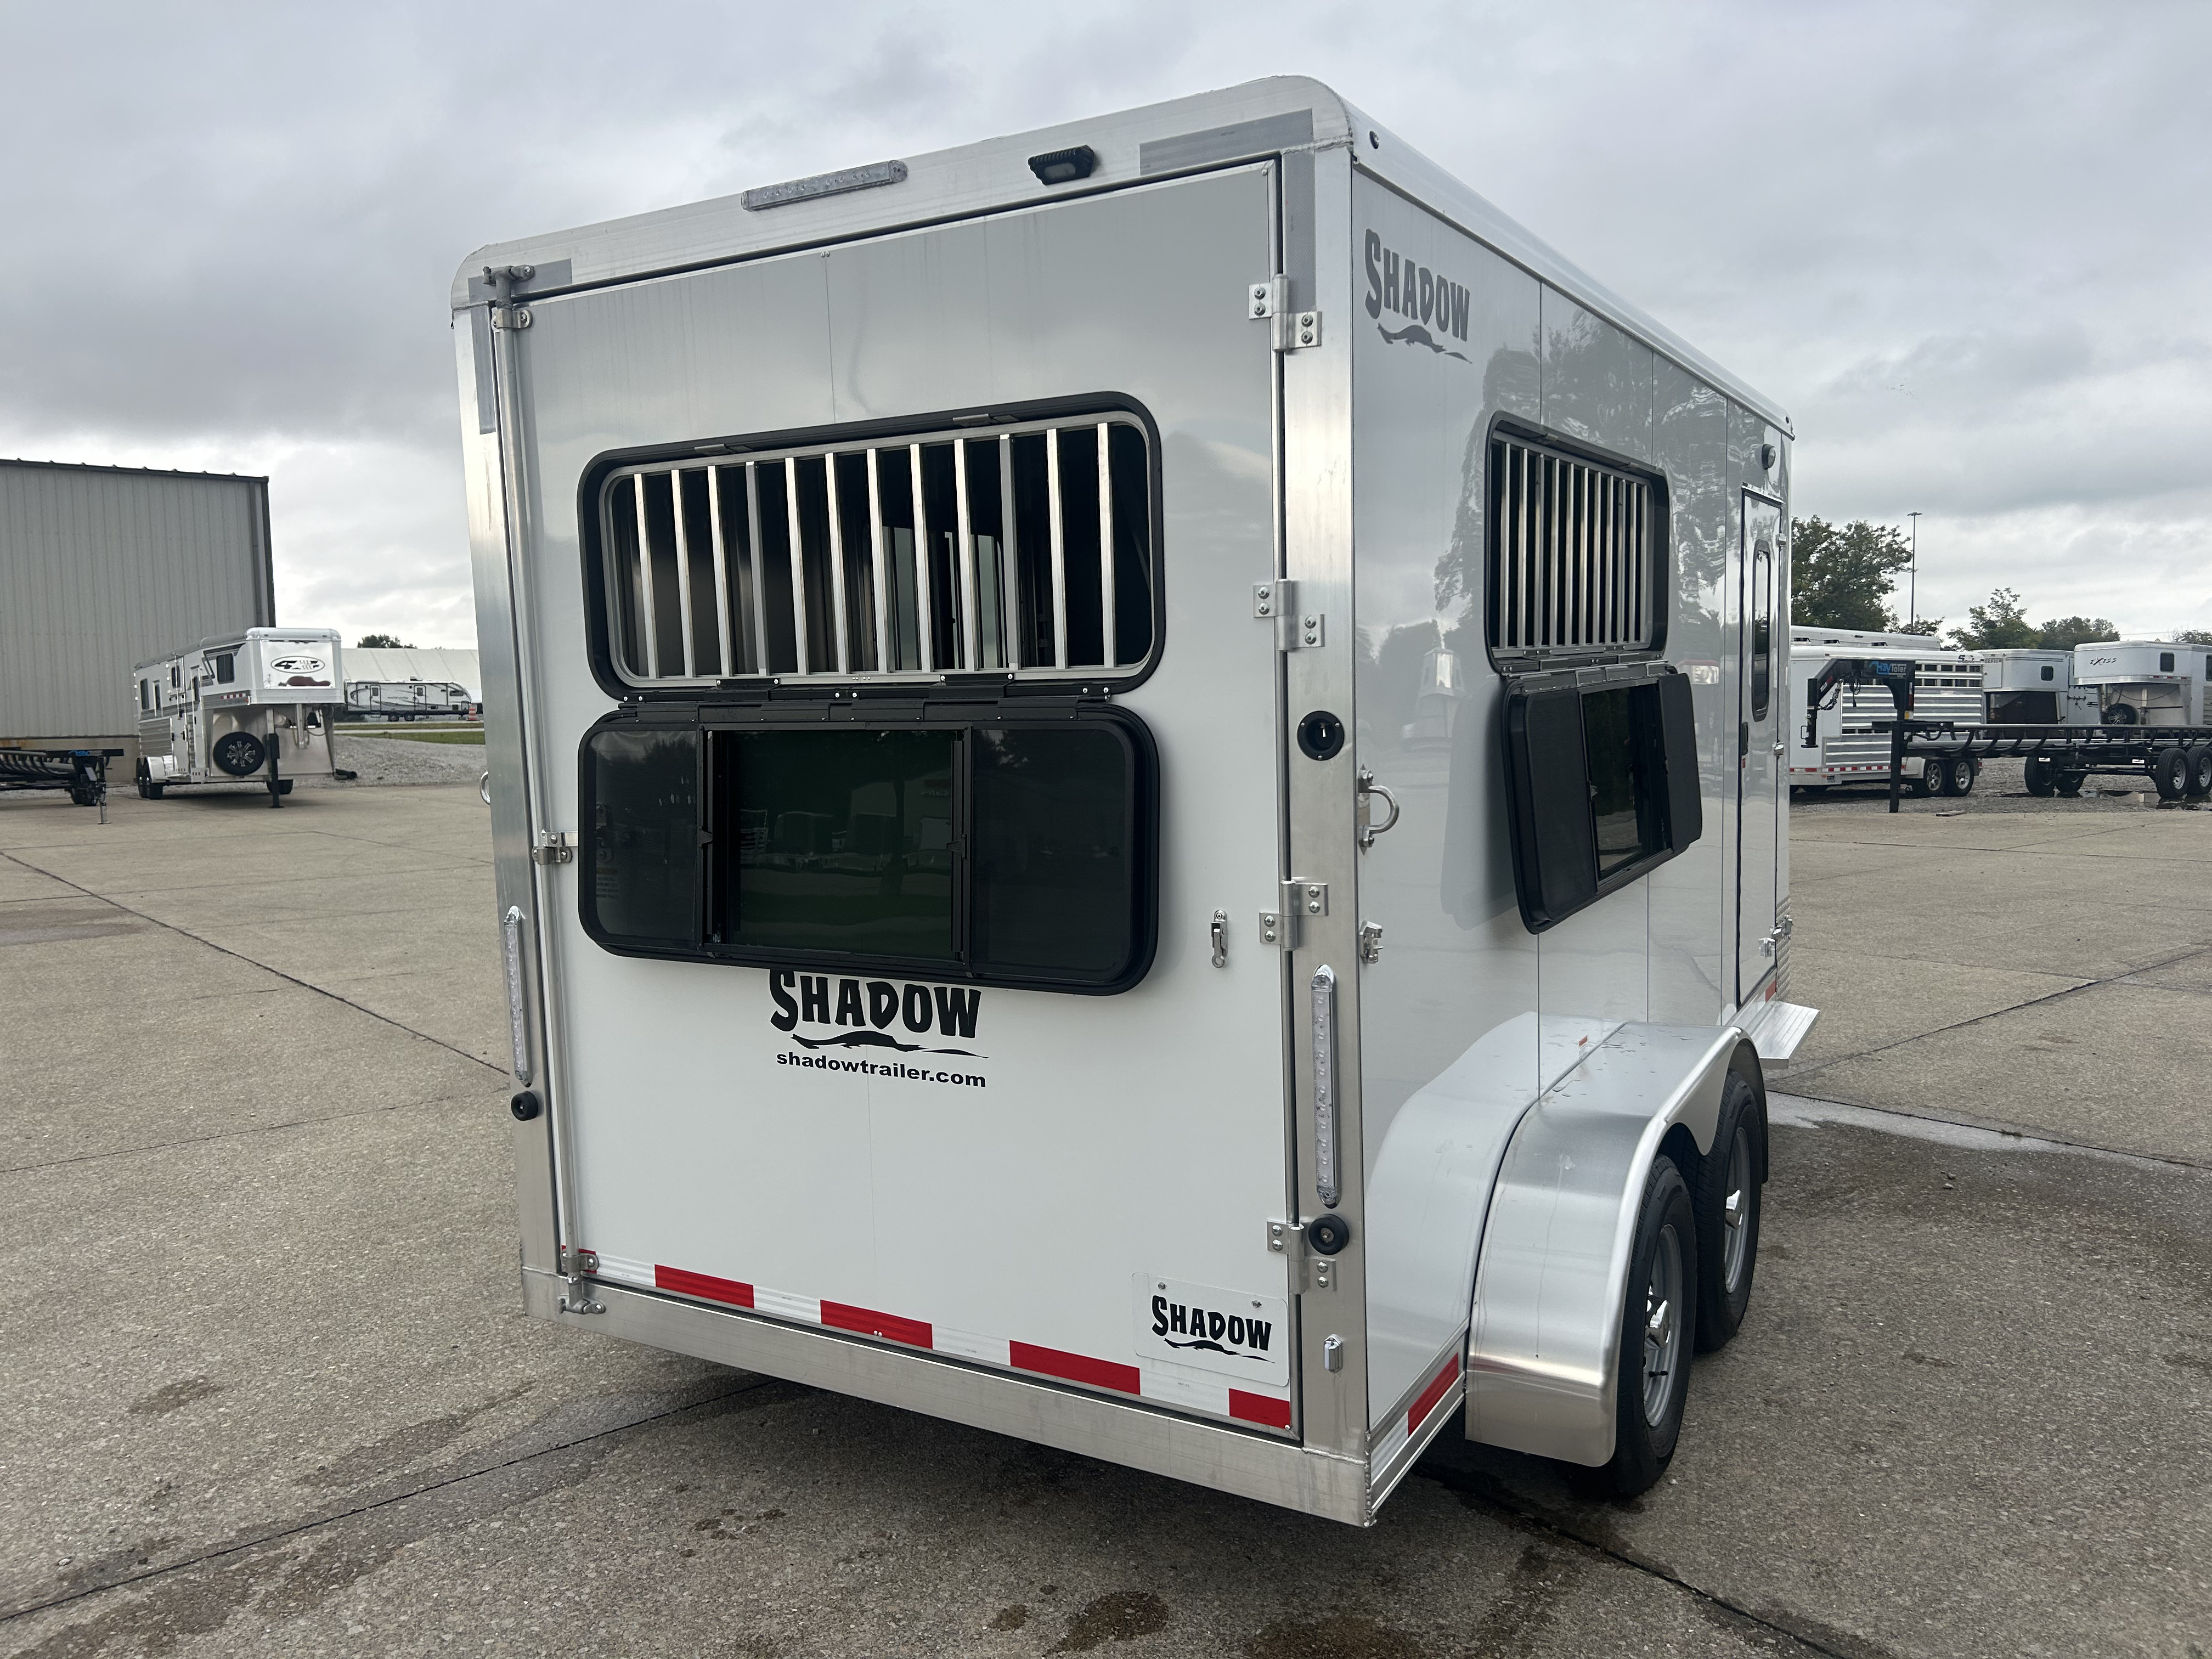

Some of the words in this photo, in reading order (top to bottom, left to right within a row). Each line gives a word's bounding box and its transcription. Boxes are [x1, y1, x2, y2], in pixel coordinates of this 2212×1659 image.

[1365, 228, 1470, 342] SHADOW
[769, 969, 982, 1039] SHADOW
[776, 1051, 986, 1088] shadowtrailer.com
[1152, 1295, 1272, 1351] SHADOW
